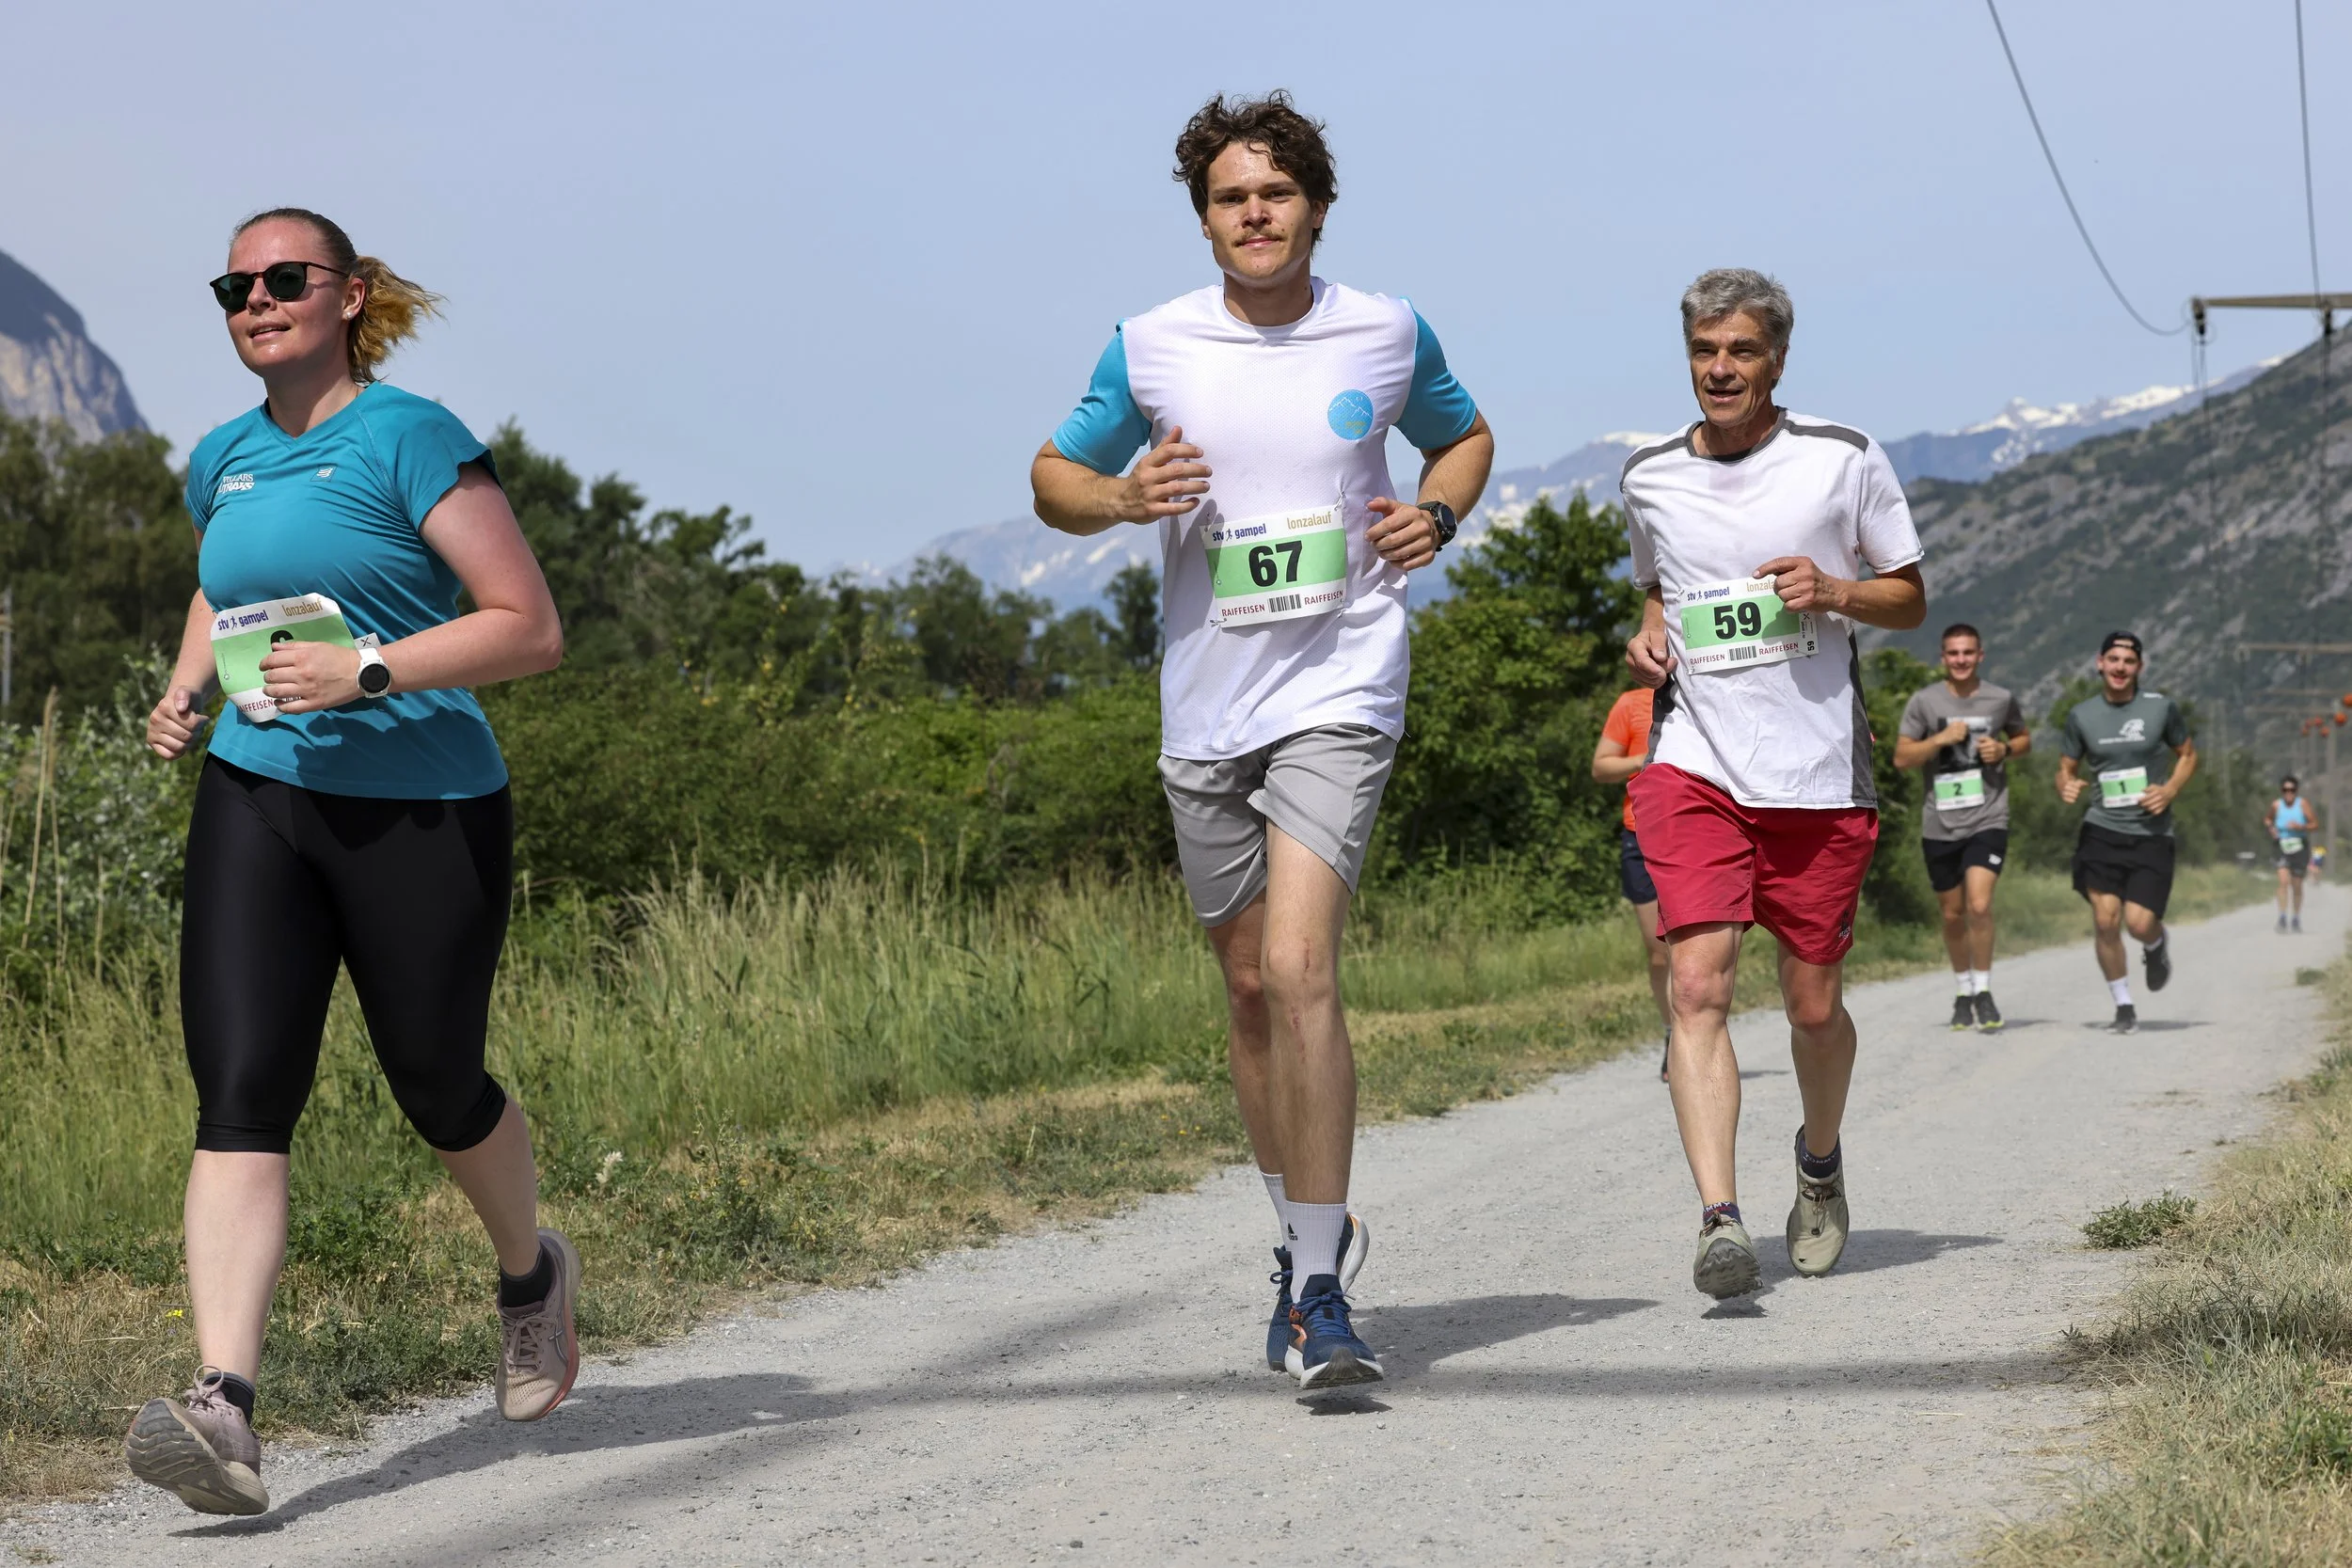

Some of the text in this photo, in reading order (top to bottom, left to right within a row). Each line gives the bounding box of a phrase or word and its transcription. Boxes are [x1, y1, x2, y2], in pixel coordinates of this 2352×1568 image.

[1287, 511, 1332, 530] lonzalauf
[1213, 523, 1266, 542] stv gampel
[1248, 540, 1303, 588] 67
[1304, 590, 1343, 605] RAIFFEISEN
[1687, 586, 1730, 601] stv gampel
[281, 597, 324, 617] lonzalauf
[1221, 604, 1265, 617] RAIFFEISEN
[217, 610, 269, 631] stv gampel
[1713, 601, 1762, 641] 59
[1758, 642, 1799, 656] RAIFFEISEN
[1806, 640, 1815, 652] 59
[1689, 654, 1725, 666] RAIFFEISEN
[1953, 783, 1963, 796] 2
[2118, 780, 2126, 794] 1
